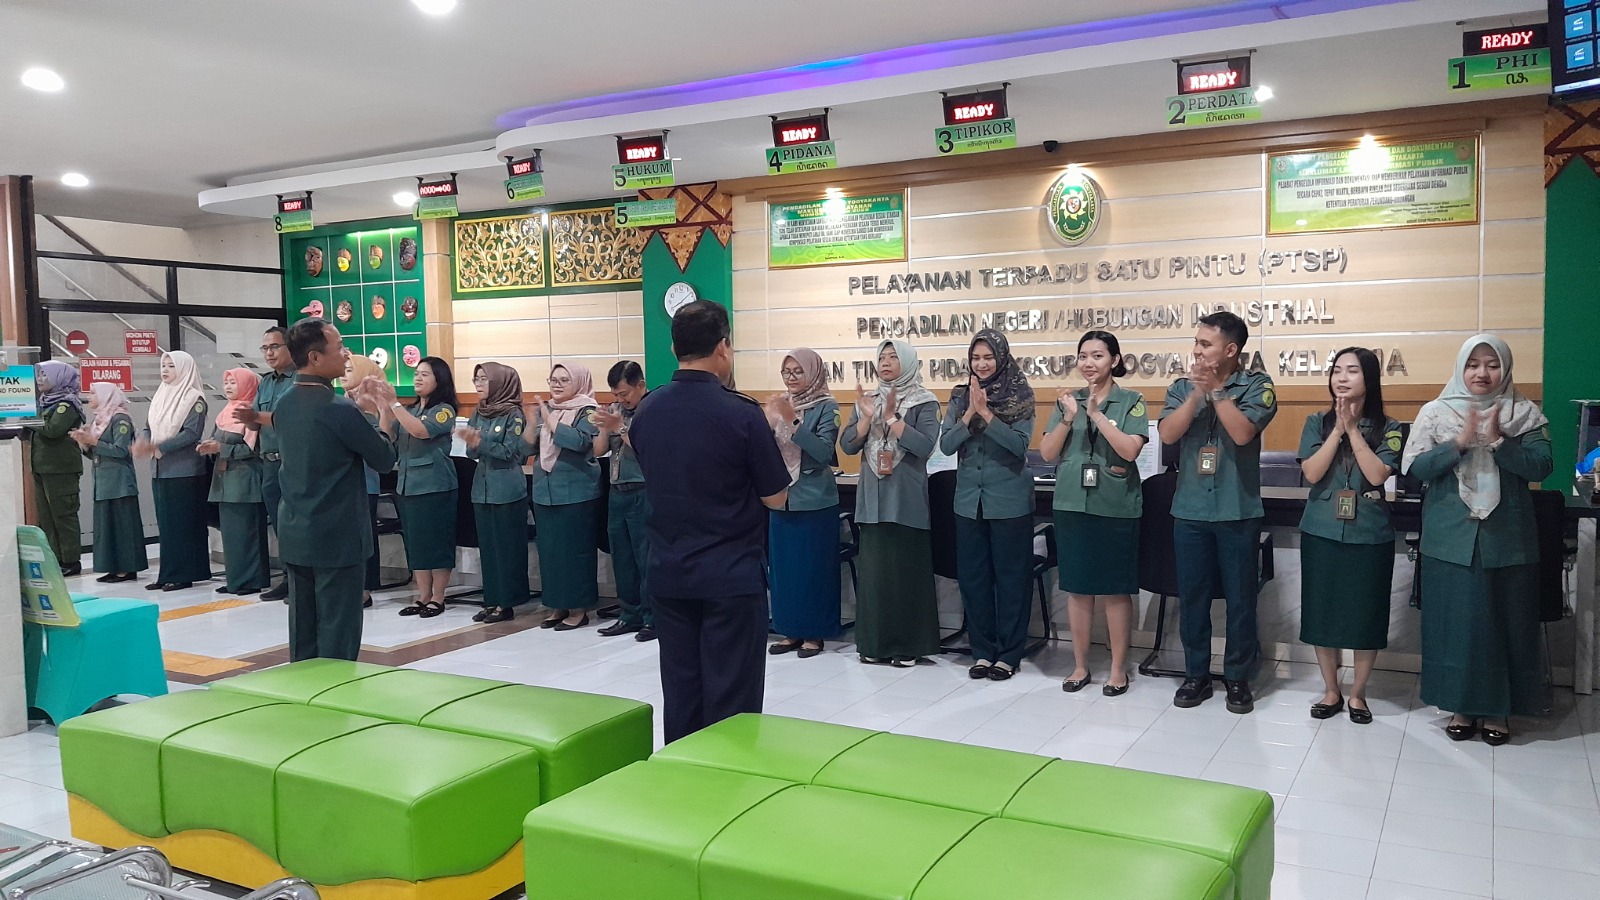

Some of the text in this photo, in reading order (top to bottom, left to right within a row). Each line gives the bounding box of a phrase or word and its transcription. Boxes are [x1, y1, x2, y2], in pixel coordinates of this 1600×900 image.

[1481, 31, 1533, 49] READY
[1452, 53, 1538, 89] 1 PHI
[1190, 72, 1237, 89] READY
[954, 104, 994, 120] READY
[1168, 92, 1258, 124] 2 PERDATA
[782, 128, 817, 142] READY
[938, 131, 954, 153] 3
[955, 122, 1013, 140] TIPIKOR
[626, 147, 657, 160] READY
[1407, 142, 1454, 153] DOKUMENTASI
[769, 145, 832, 172] 4 PIDANA
[1416, 158, 1444, 167] PUBLIK
[614, 168, 627, 187] 5
[627, 163, 670, 176] HUKUM
[506, 182, 515, 199] 6
[617, 206, 628, 224] 5
[275, 217, 282, 231] 8
[848, 247, 1347, 295] PELAYANAN TERPADU SATU PINTU (PTSP)
[857, 313, 976, 337] PENGADILAN
[980, 309, 1049, 332] NEGERI
[92, 369, 121, 380] DILARANG
